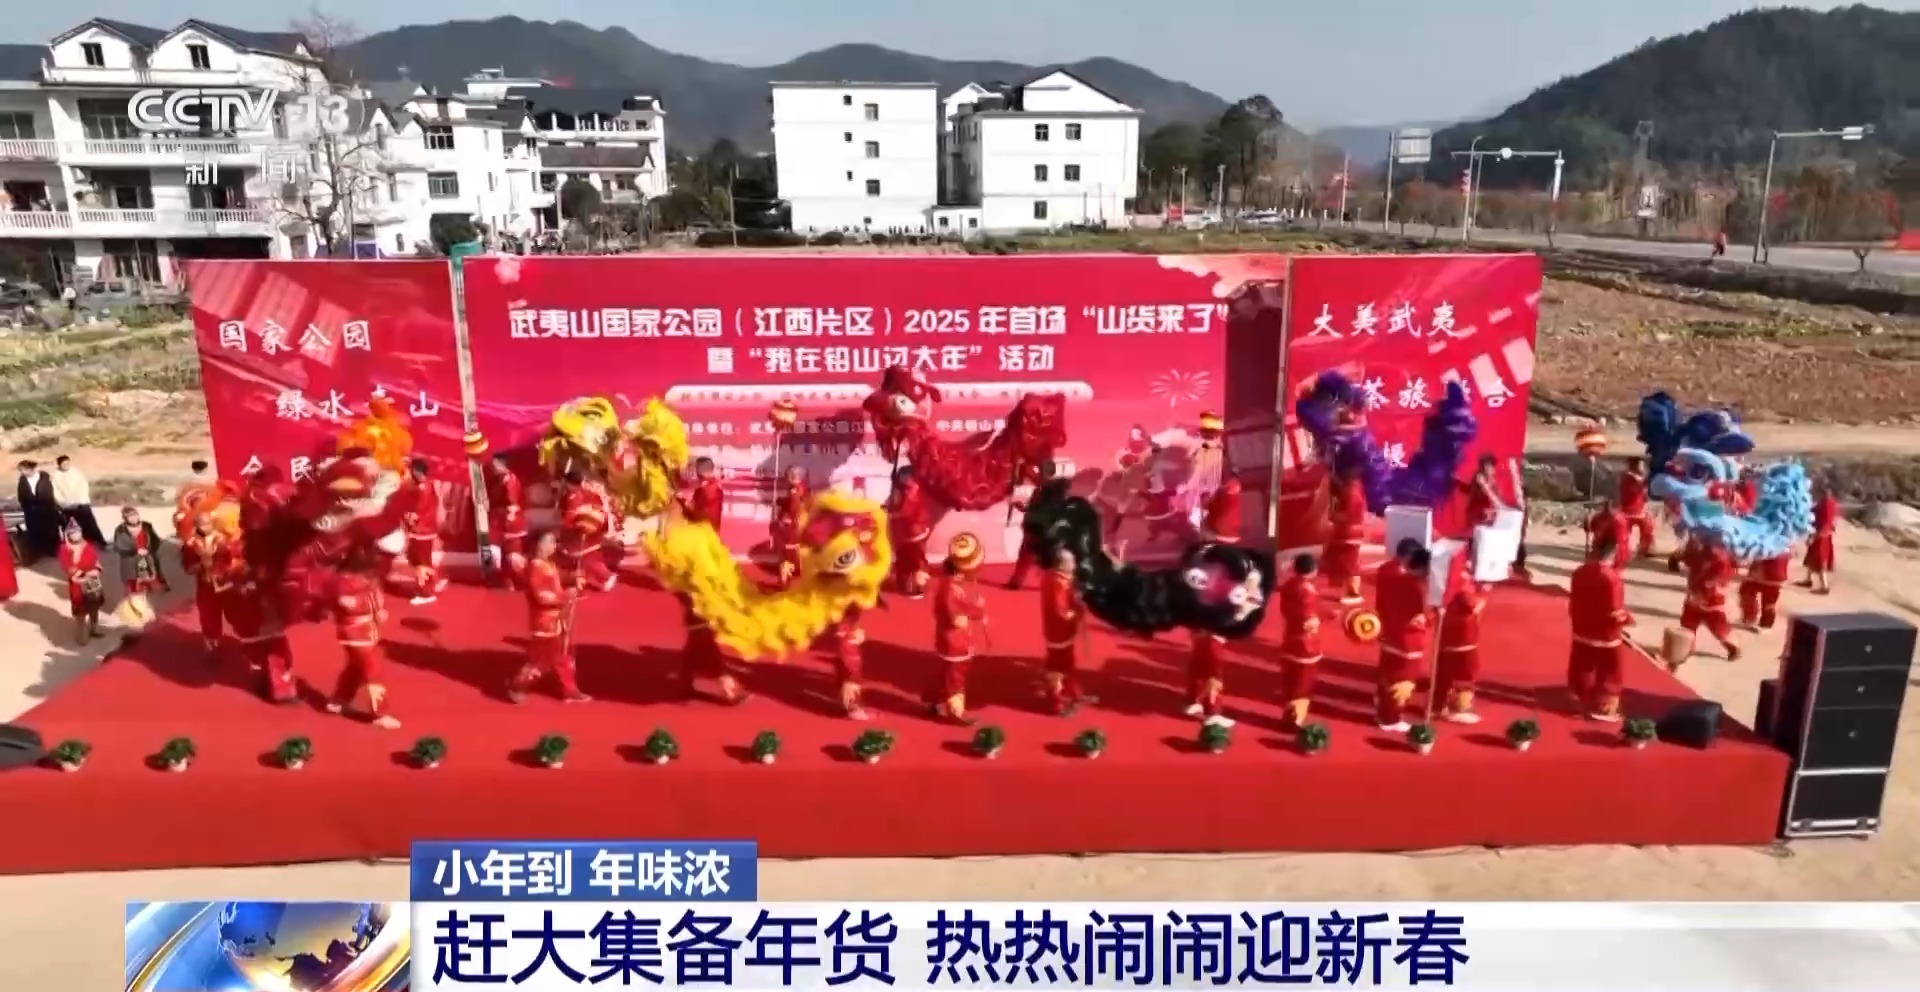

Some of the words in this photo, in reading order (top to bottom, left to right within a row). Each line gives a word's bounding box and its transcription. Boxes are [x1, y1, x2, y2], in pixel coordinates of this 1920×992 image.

[219, 319, 371, 355] 国家公园
[1308, 301, 1462, 338] 大美武夷
